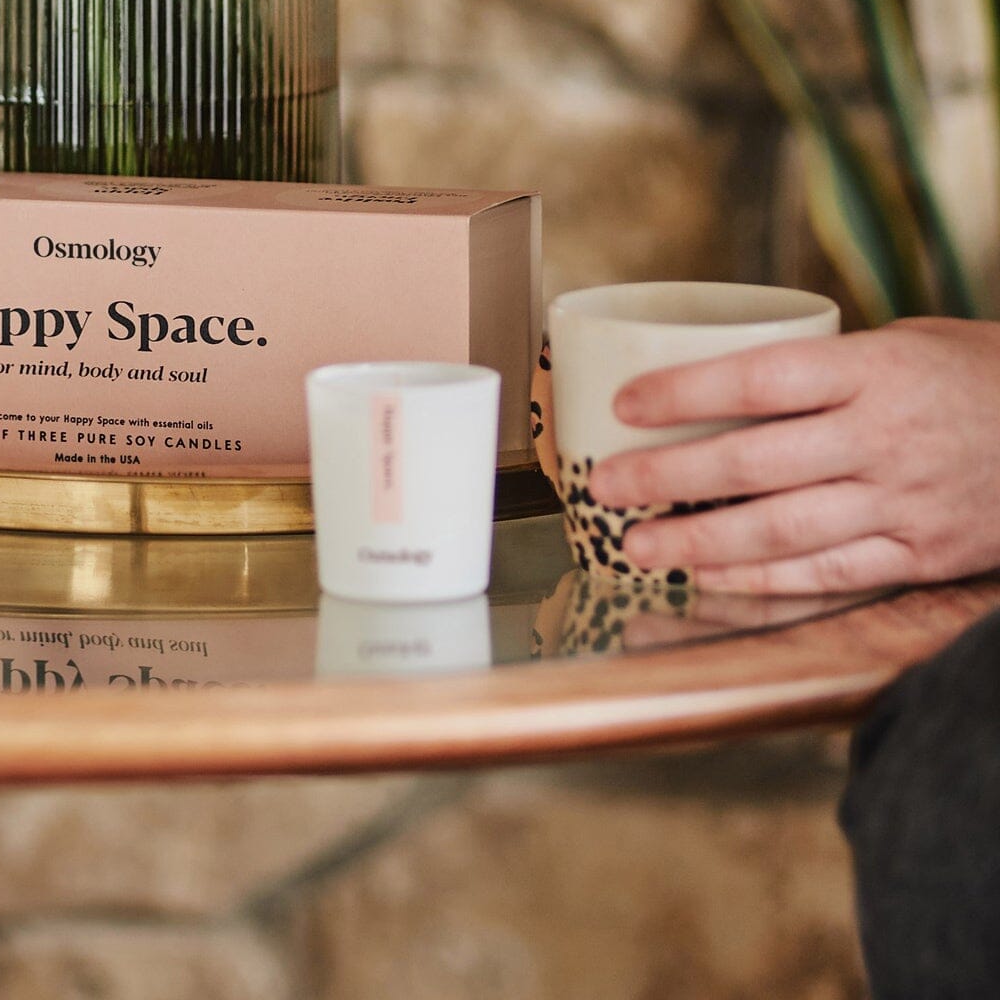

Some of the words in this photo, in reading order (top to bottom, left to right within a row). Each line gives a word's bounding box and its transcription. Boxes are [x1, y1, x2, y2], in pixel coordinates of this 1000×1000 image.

[33, 235, 161, 268] Osmology
[107, 300, 268, 352] Space.
[19, 361, 72, 379] mind,
[78, 362, 123, 381] body
[127, 365, 164, 381] and
[168, 367, 208, 383] soul
[26, 413, 36, 423] to
[39, 416, 60, 426] your
[63, 414, 93, 427] Happy
[97, 415, 125, 428] Space
[128, 416, 150, 428] with
[153, 418, 194, 430] essential
[197, 420, 214, 430] oils
[18, 430, 68, 443] THREE
[77, 432, 117, 445] PURE
[126, 435, 156, 447] SOY
[164, 436, 243, 451] CANDLES
[54, 452, 84, 464] Made
[87, 453, 97, 464] in
[100, 453, 117, 465] the
[119, 454, 141, 465] USA
